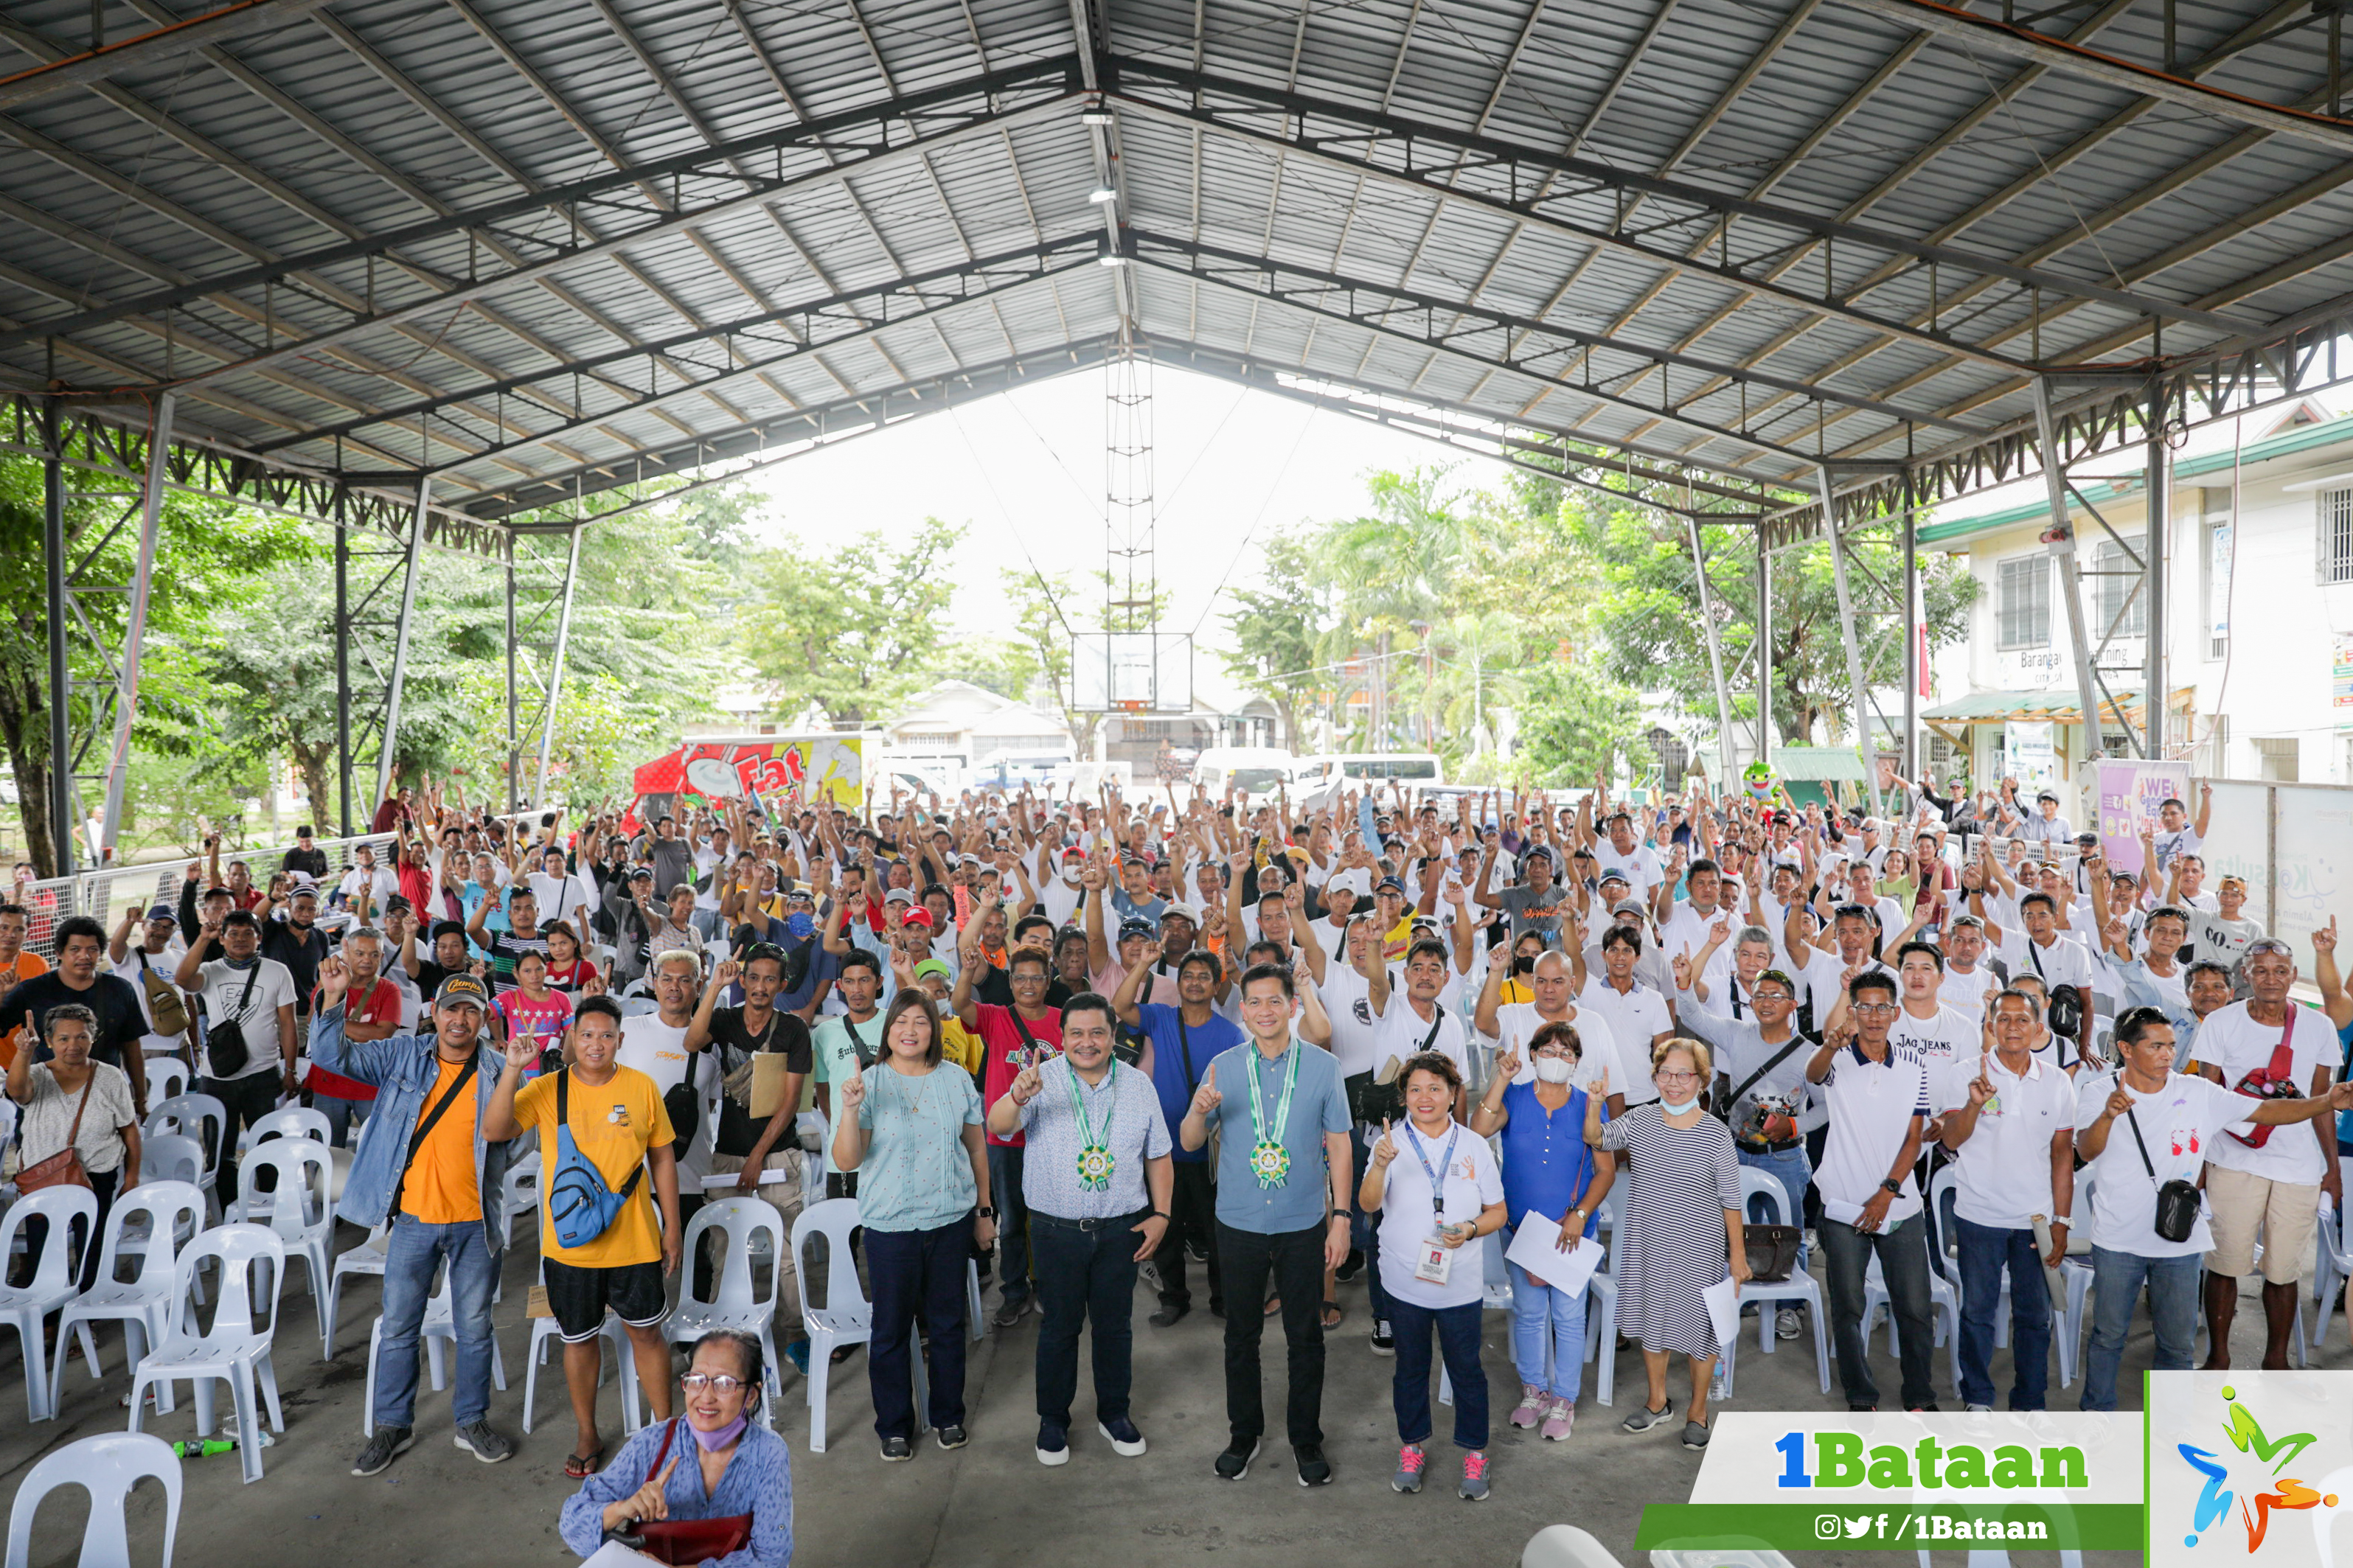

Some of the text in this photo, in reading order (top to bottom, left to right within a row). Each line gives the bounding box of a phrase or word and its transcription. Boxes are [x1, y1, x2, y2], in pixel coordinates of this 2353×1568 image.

[734, 745, 806, 801] Eat
[2146, 778, 2171, 798] WE
[2141, 795, 2163, 807] Gend
[838, 1044, 855, 1059] Fub
[1425, 1164, 1436, 1179] DSWD
